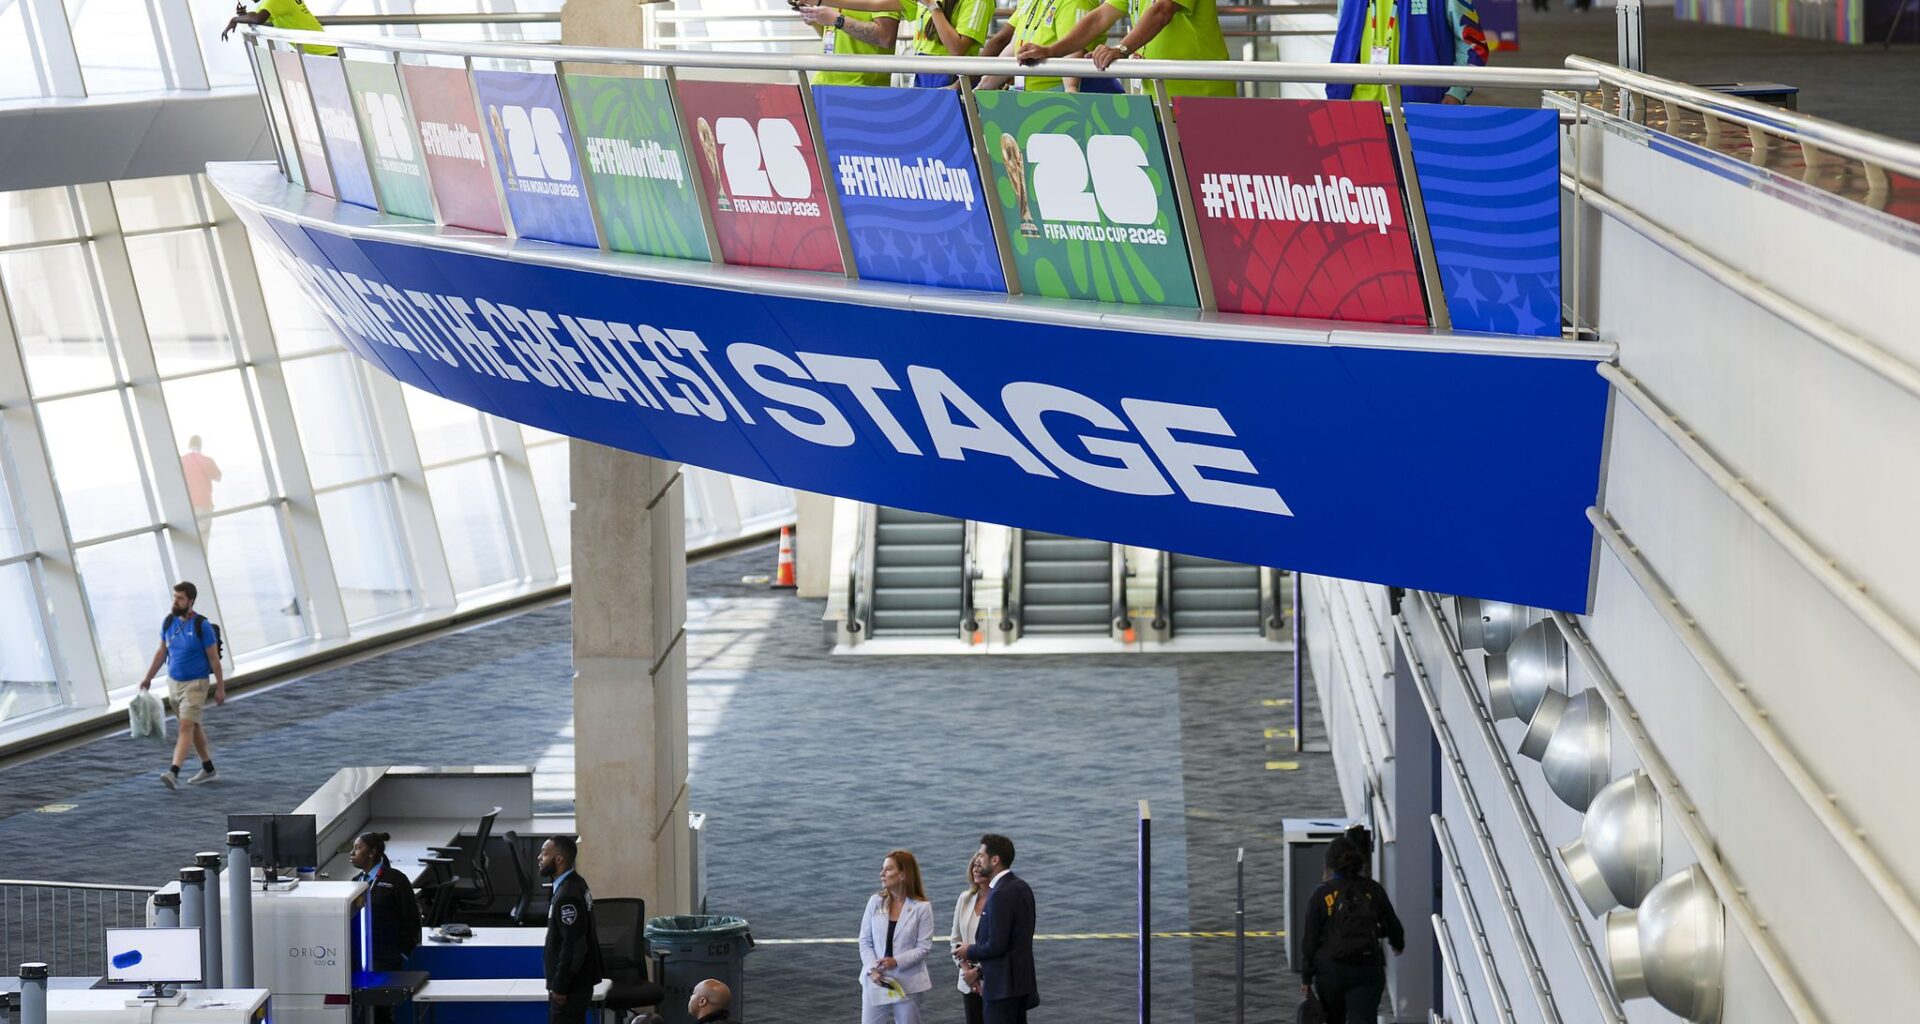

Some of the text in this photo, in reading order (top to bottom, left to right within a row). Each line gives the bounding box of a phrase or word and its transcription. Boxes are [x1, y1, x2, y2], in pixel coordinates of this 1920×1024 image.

[502, 105, 572, 181] 26
[586, 136, 683, 188] #FIFAWorldCup
[715, 117, 812, 199] 26
[733, 199, 820, 217] FIFA WORLD CUP 2026
[838, 154, 974, 211] #FIFAWorldCup
[1026, 133, 1159, 225] 26
[1200, 173, 1392, 235] #FIFAWorldCup
[1043, 223, 1168, 245] FIFA WORLD CUP 2026
[403, 289, 531, 383] THE
[475, 298, 757, 425] GREATEST
[726, 342, 1295, 517] STAGE
[289, 945, 336, 959] ORION
